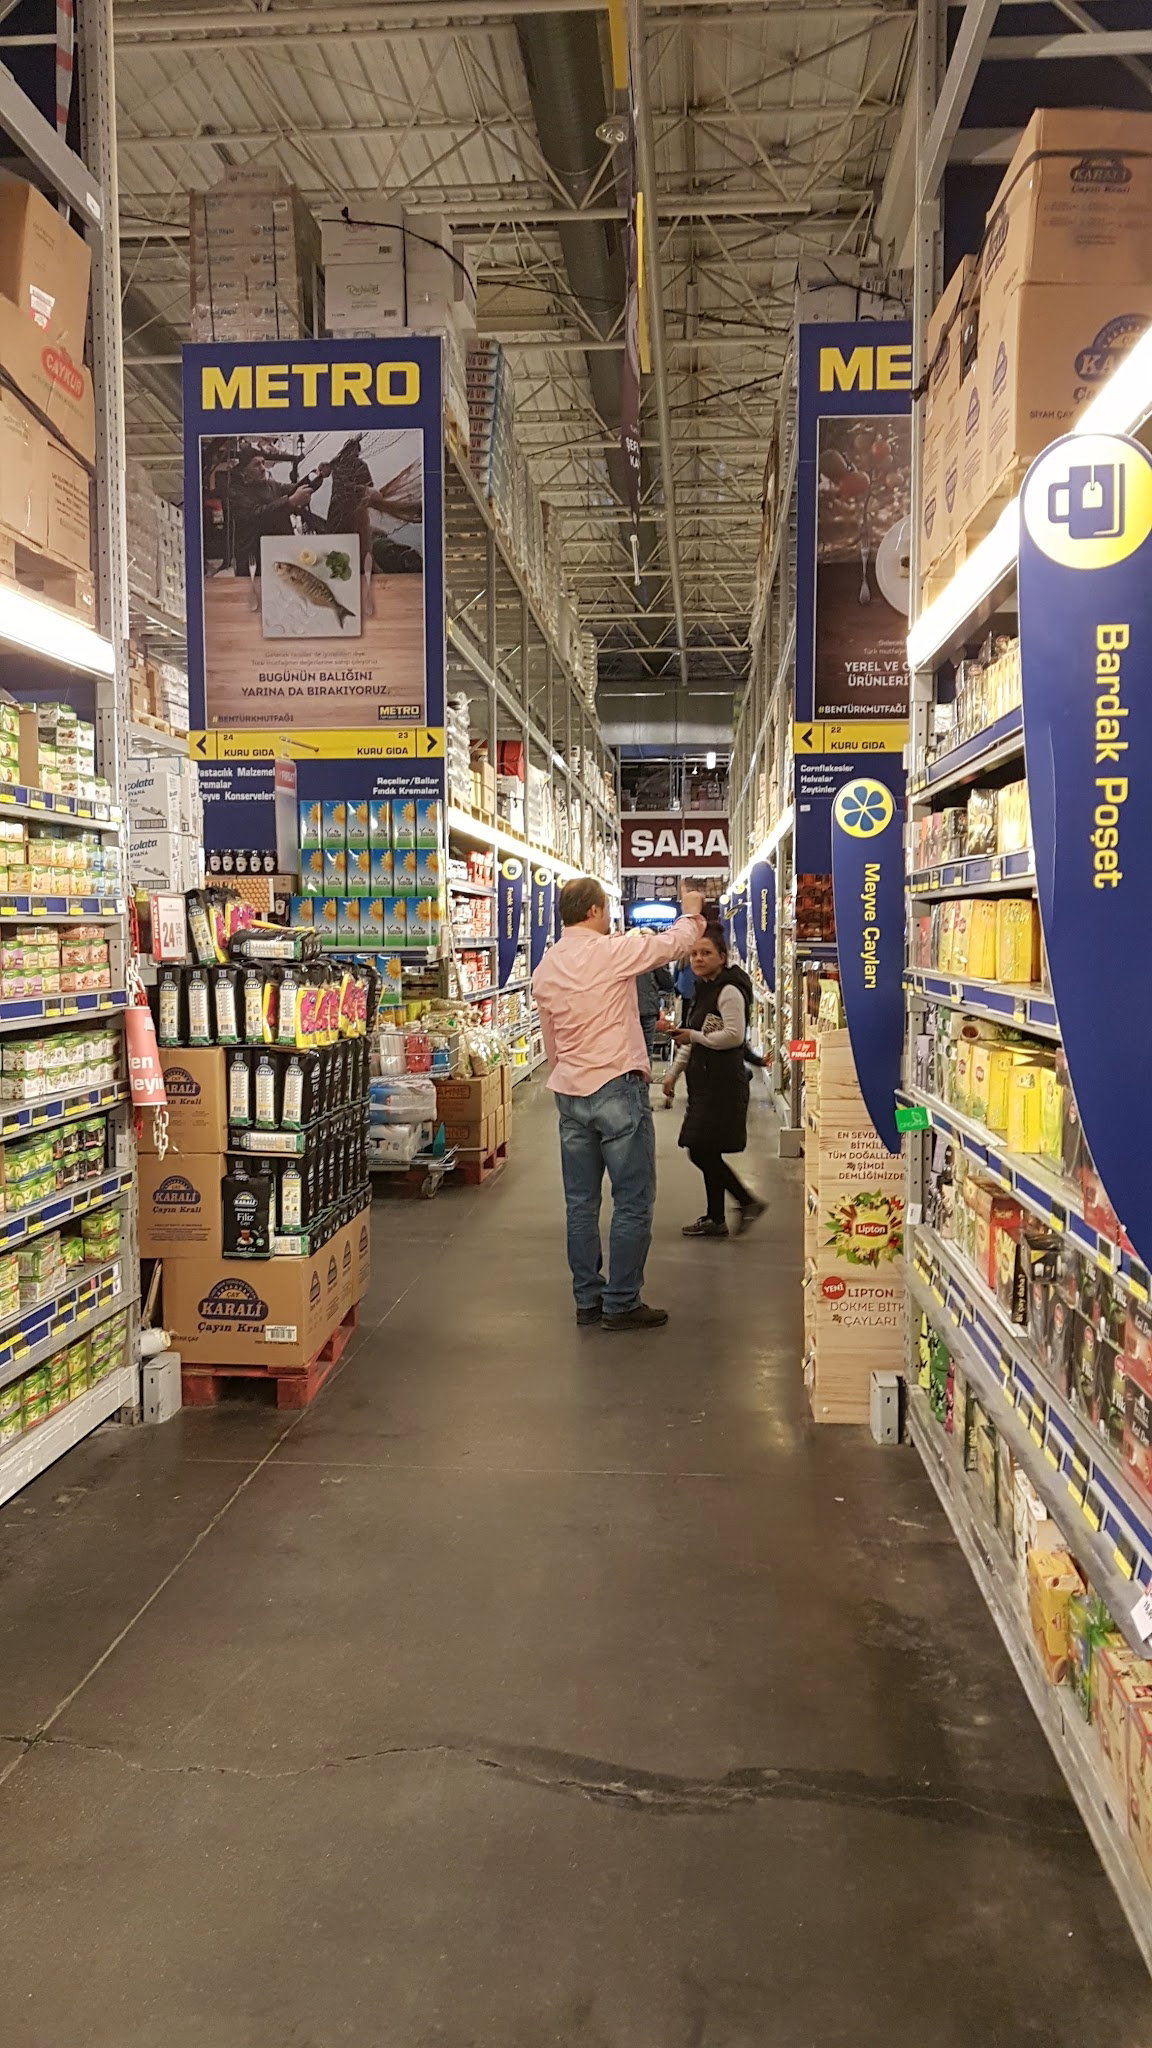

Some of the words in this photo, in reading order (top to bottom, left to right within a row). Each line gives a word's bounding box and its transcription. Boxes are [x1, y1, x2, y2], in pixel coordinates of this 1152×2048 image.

[819, 345, 912, 392] ME
[201, 361, 421, 410] METRO
[844, 661, 881, 673] YEREL
[883, 660, 899, 672] VE
[258, 669, 317, 682] BUGÜNÜN
[319, 668, 373, 682] BALIĞINI
[847, 674, 910, 687] ÜRÜNLERİ
[241, 687, 285, 697] YARINA
[288, 686, 304, 697] DA
[1095, 623, 1130, 765] Bardak
[379, 705, 420, 715] METRO
[817, 704, 907, 714] #BENTÜRKMUTFAĞI
[398, 731, 409, 739] 23
[830, 726, 842, 734] 22
[356, 747, 383, 755] KURU
[385, 747, 409, 755] GIDA
[830, 741, 859, 750] KURU
[861, 741, 886, 750] GIDA
[224, 749, 250, 757] KURU
[252, 748, 275, 757] GIDA
[800, 774, 834, 783] Helvalar
[1090, 776, 1129, 890] Poşet
[631, 829, 729, 862] ŞARA
[860, 863, 881, 922] Meyve
[162, 922, 175, 948] 24
[860, 926, 881, 989] Çayları
[128, 1052, 154, 1069] en
[837, 1131, 849, 1139] EN
[828, 1151, 848, 1160] TÜM
[857, 1161, 885, 1171] ŞİMDİ
[838, 1172, 905, 1180] DEMLİĞİNİZDE
[236, 1212, 255, 1222] Filiz
[857, 1225, 886, 1234] Lipton
[823, 1283, 845, 1293] YENİ
[848, 1288, 894, 1298] LIPTON
[201, 1302, 264, 1317] KARALİ
[830, 1300, 875, 1312] DÖKME
[197, 1322, 232, 1333] Çayın
[843, 1316, 897, 1328] ÇAYLARI
